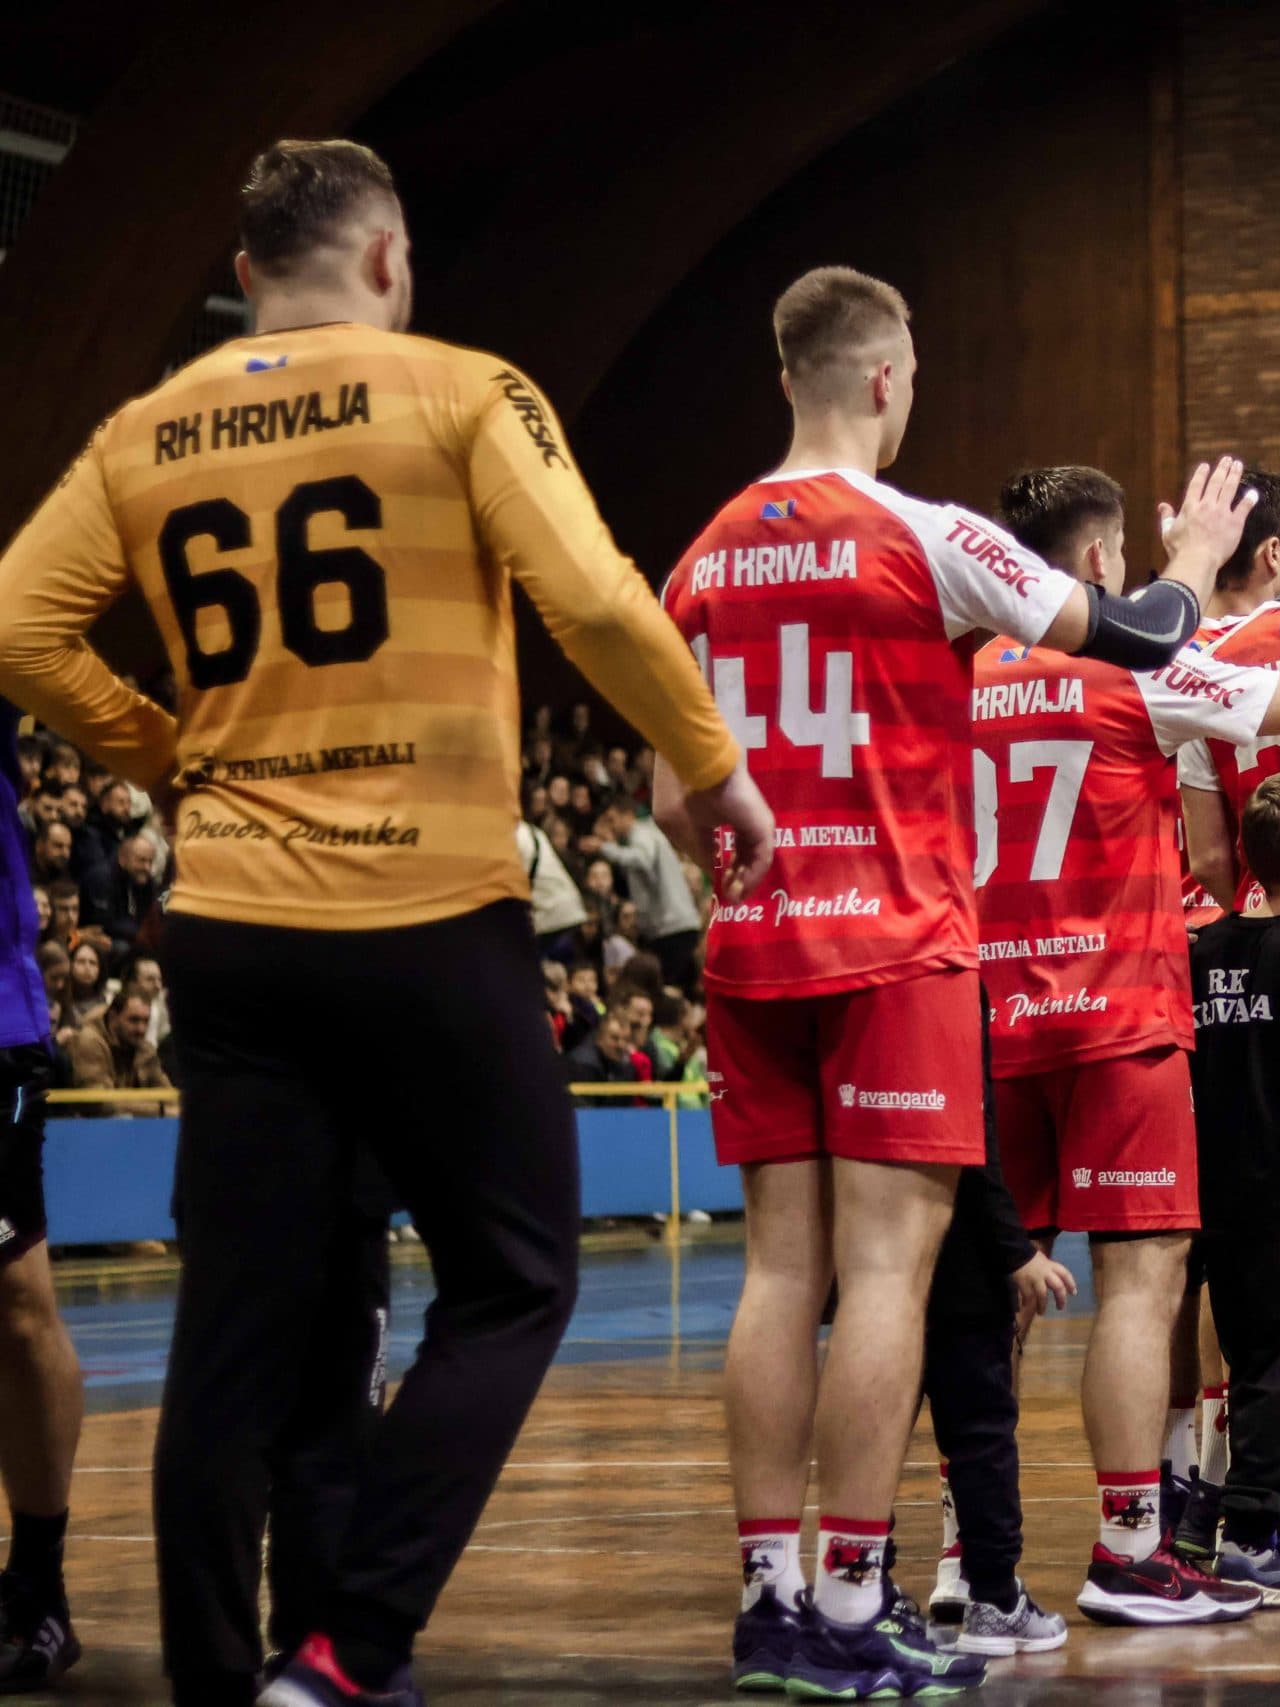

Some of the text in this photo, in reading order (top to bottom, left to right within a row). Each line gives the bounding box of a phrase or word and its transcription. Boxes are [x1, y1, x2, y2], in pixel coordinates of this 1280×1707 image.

[155, 413, 202, 466] RK
[211, 382, 370, 450] KRIVAJA
[157, 475, 390, 691] 66
[691, 540, 857, 596] RK KRIVAJA
[690, 623, 870, 778] 44
[320, 742, 416, 773] METALI
[800, 825, 878, 847] METALI
[771, 887, 881, 928] Putnika
[977, 933, 1107, 961] RIVAJA METALI
[1208, 968, 1250, 995] RK
[1006, 987, 1108, 1027] Putnika
[858, 1089, 946, 1110] avangarde
[1097, 1167, 1177, 1187] avangarde
